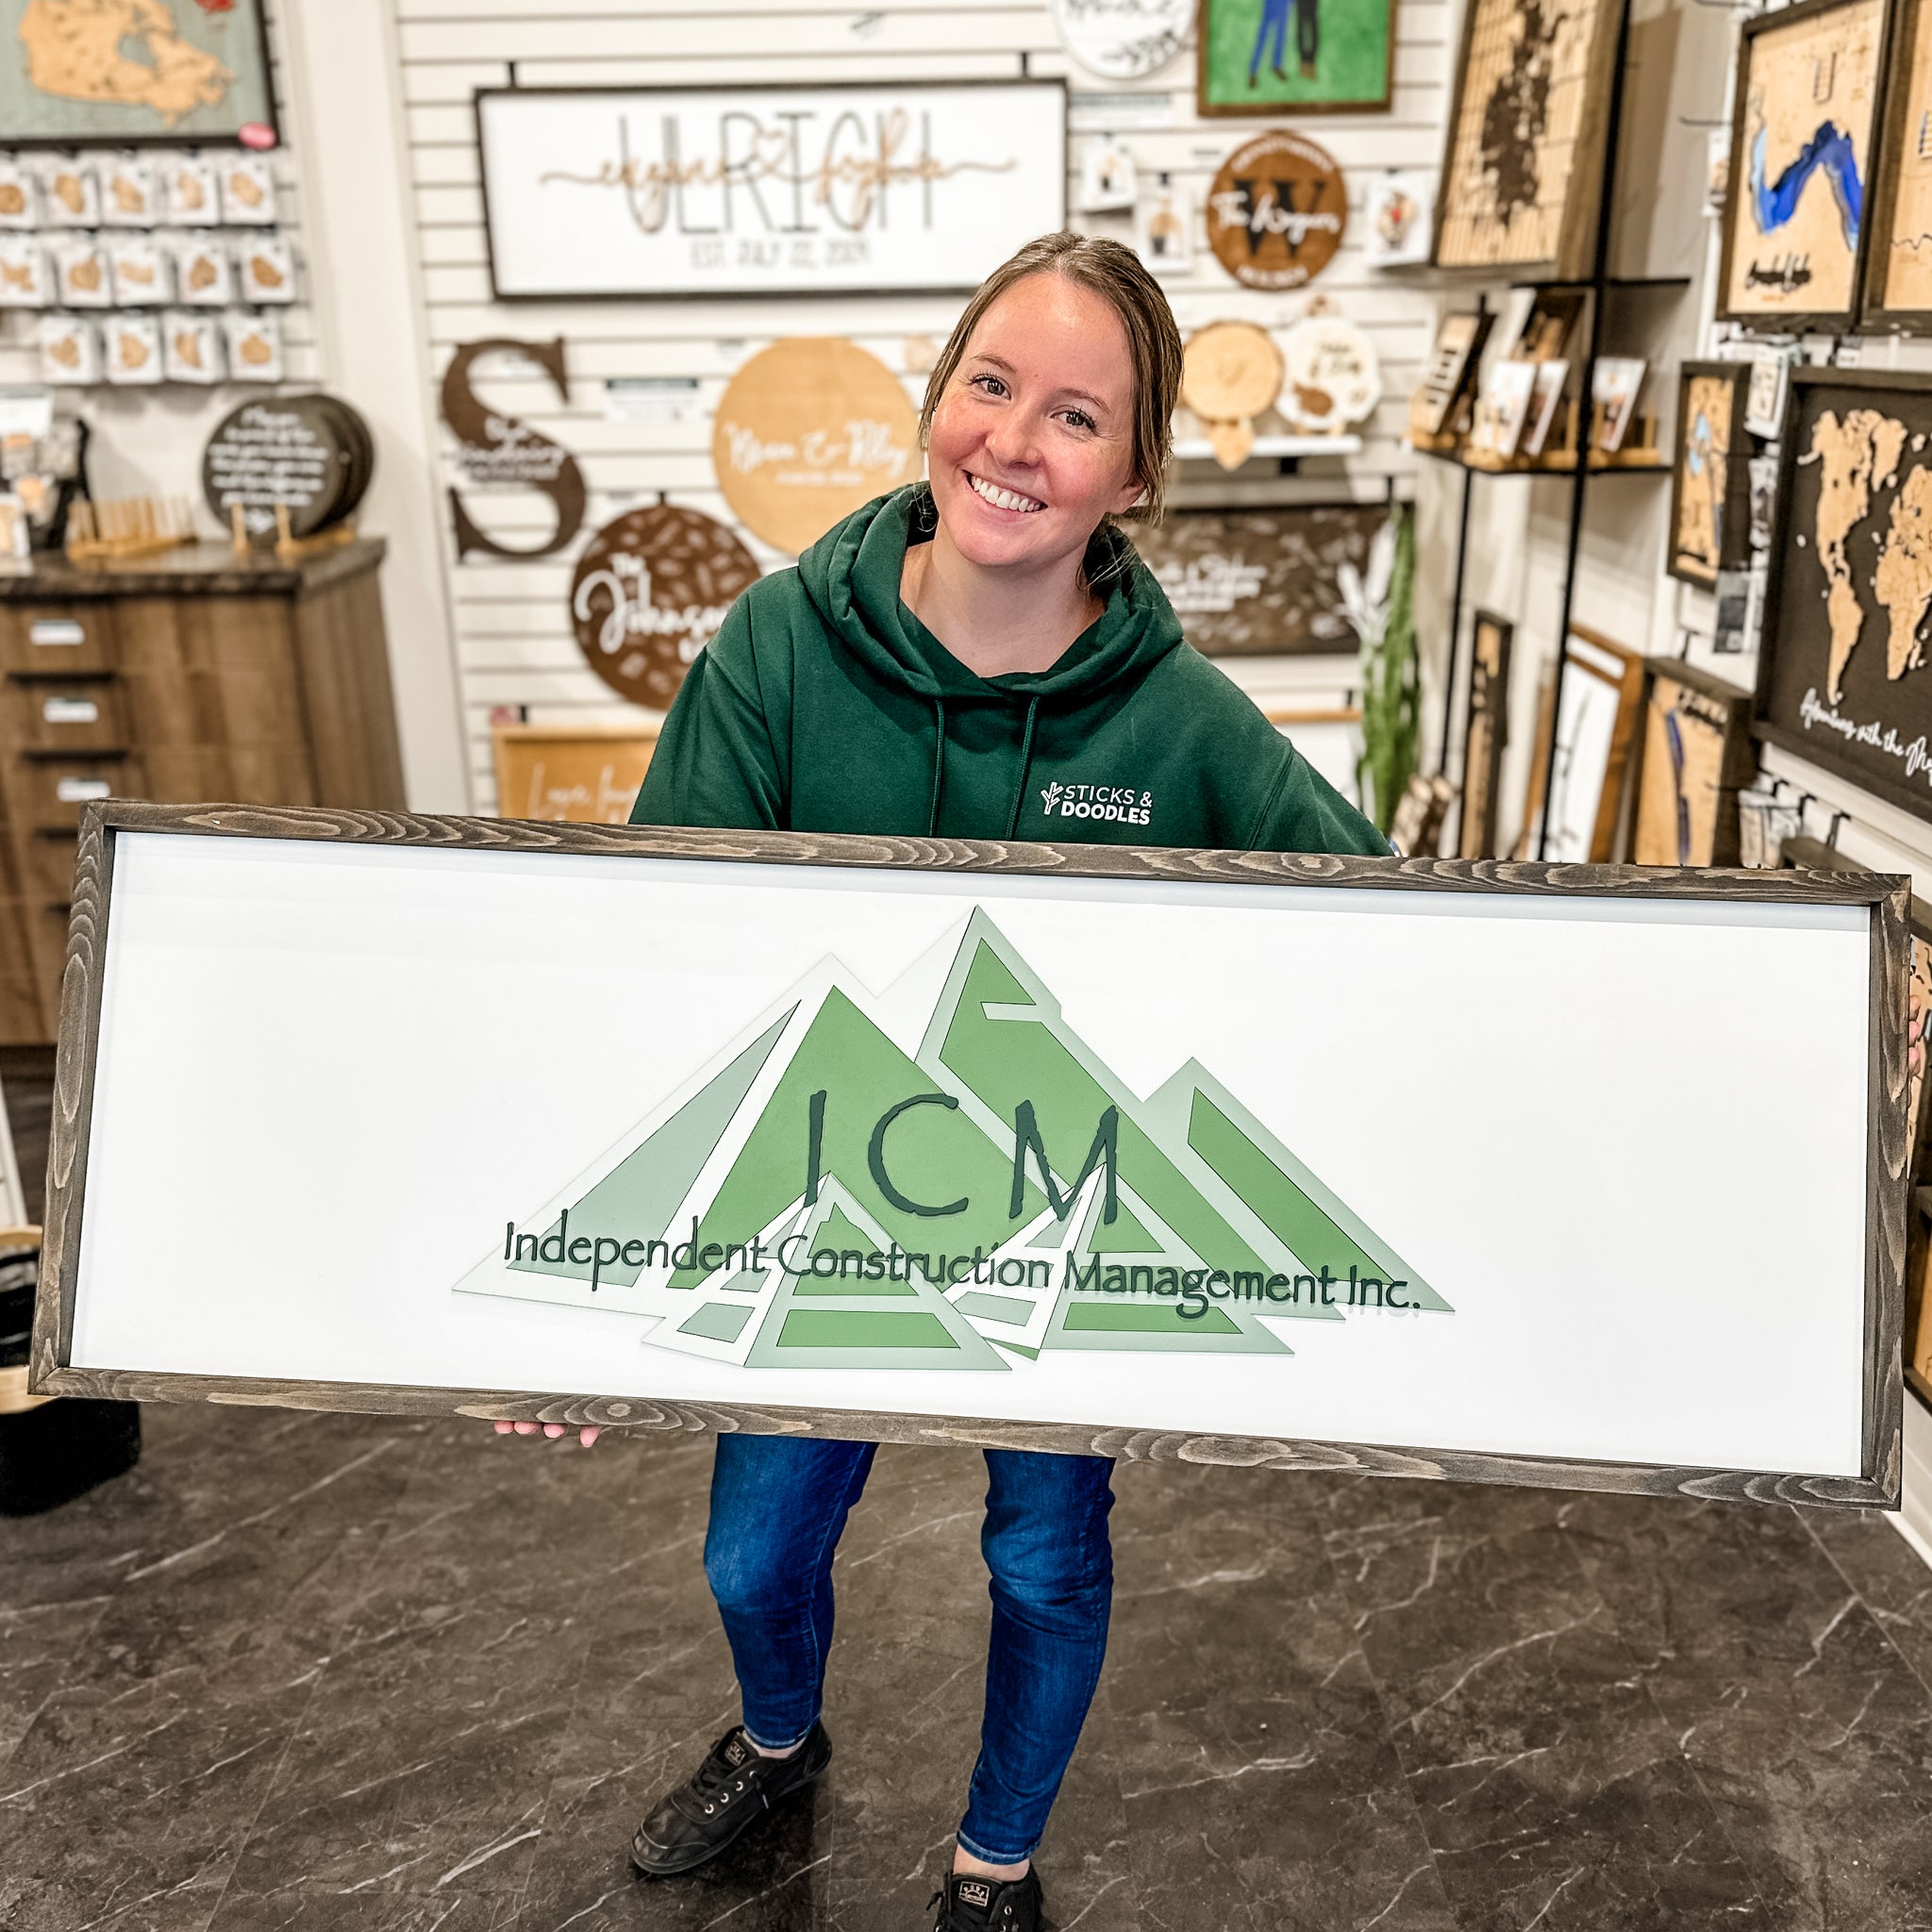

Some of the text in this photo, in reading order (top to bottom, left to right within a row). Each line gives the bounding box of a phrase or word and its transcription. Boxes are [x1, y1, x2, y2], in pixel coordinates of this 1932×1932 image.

[617, 109, 933, 236] ULRICH
[1883, 728, 1904, 758] the
[1063, 784, 1153, 808] STICKS &
[1060, 800, 1151, 825] DOODLES
[504, 1208, 1421, 1319] Independent Construction Management Inc.
